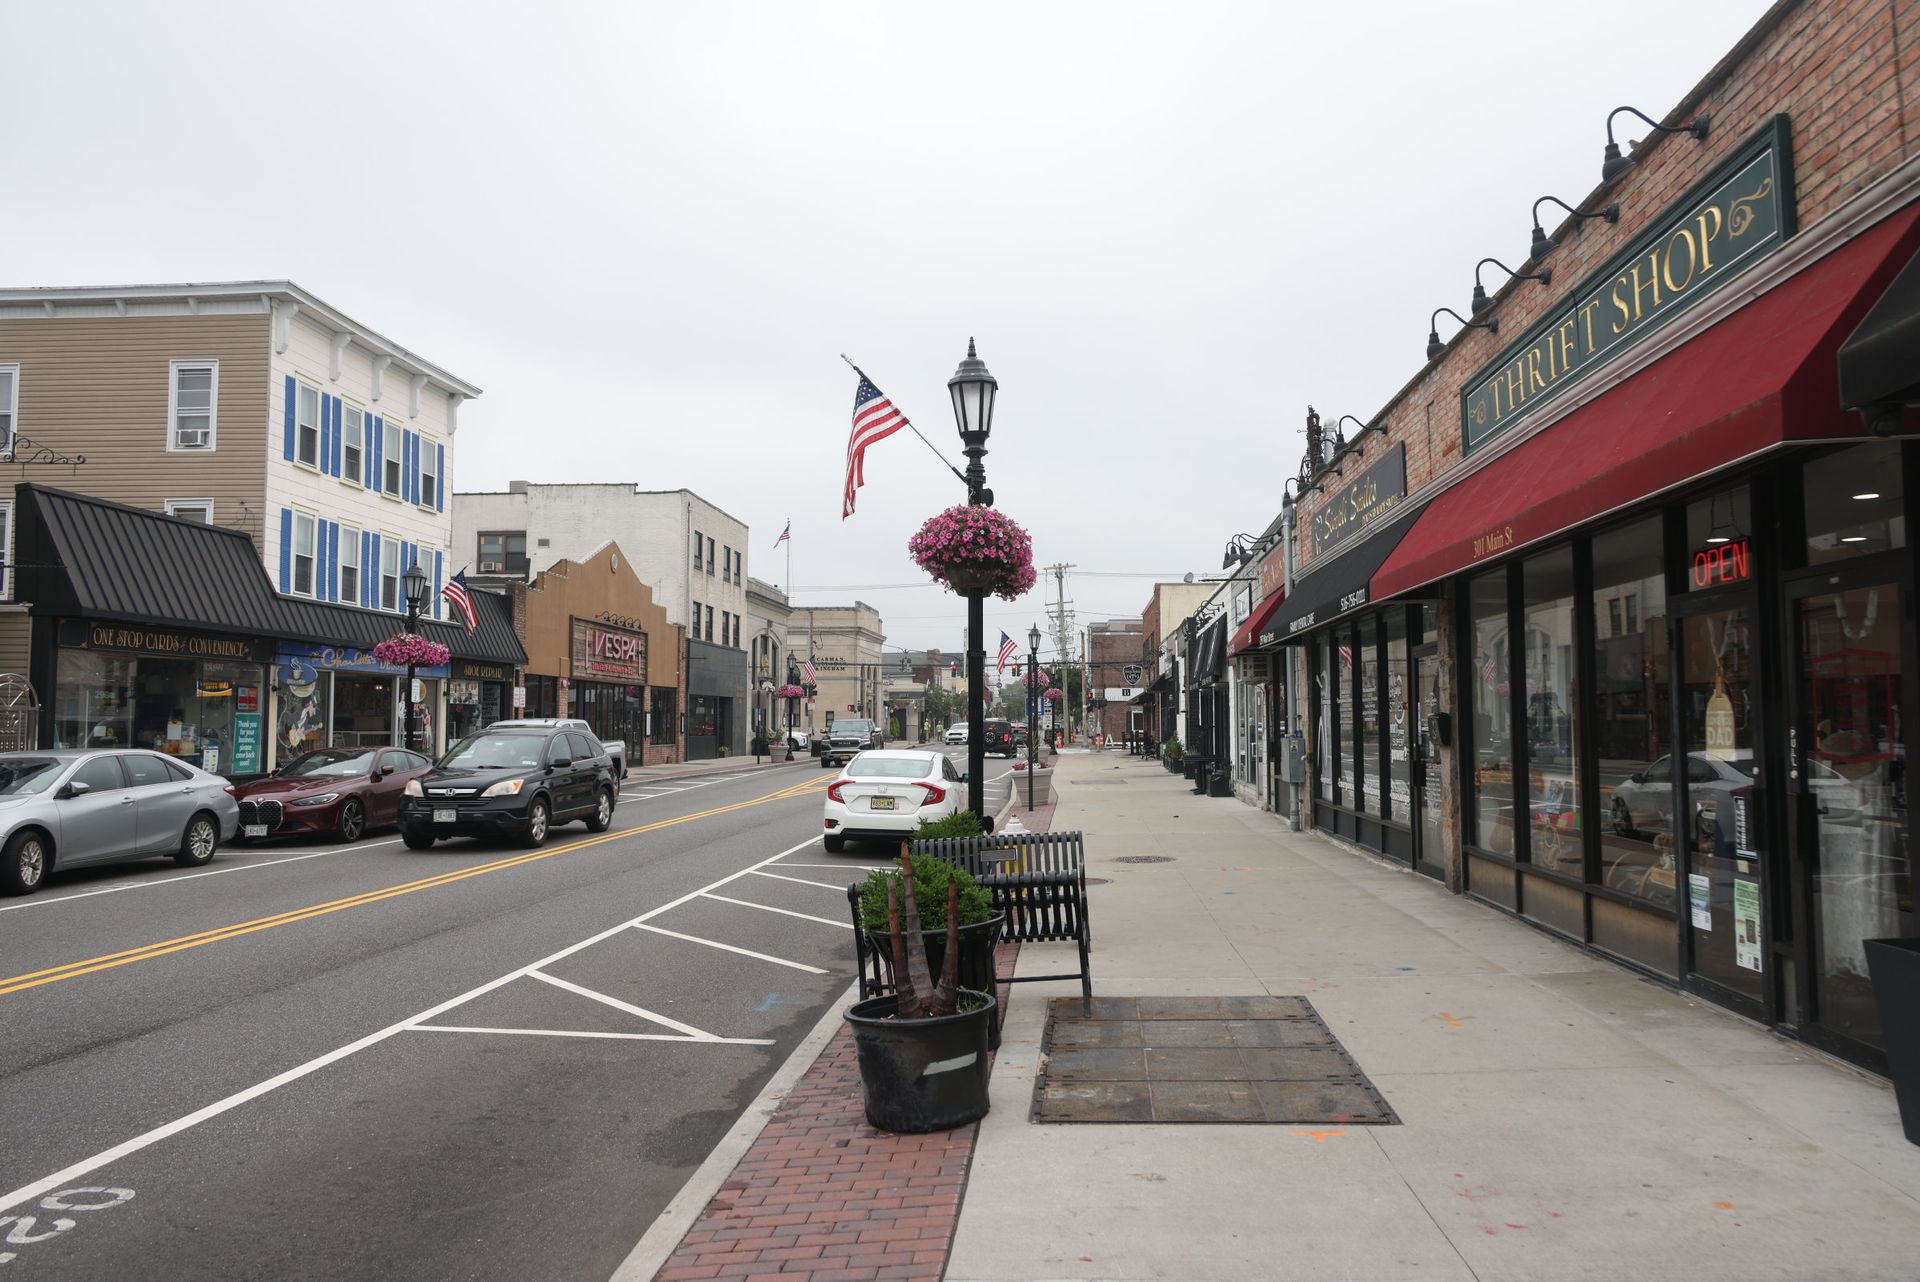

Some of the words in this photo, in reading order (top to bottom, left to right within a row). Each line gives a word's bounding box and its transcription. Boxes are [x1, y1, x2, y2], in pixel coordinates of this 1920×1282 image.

[1489, 297, 1601, 422] THRIFT
[1612, 204, 1722, 334] SHOP
[1473, 538, 1485, 559] 301
[1486, 530, 1504, 553] Main
[1505, 526, 1513, 545] St
[1694, 541, 1748, 587] OPEN
[93, 628, 114, 646] ONE
[117, 630, 143, 648] STOP
[146, 633, 179, 652] CARDS
[189, 638, 245, 657] CONVENIENCE
[593, 630, 637, 661] VESPA
[480, 666, 503, 678] REPAIR
[238, 720, 249, 728] Thank
[1707, 727, 1733, 745] DAD
